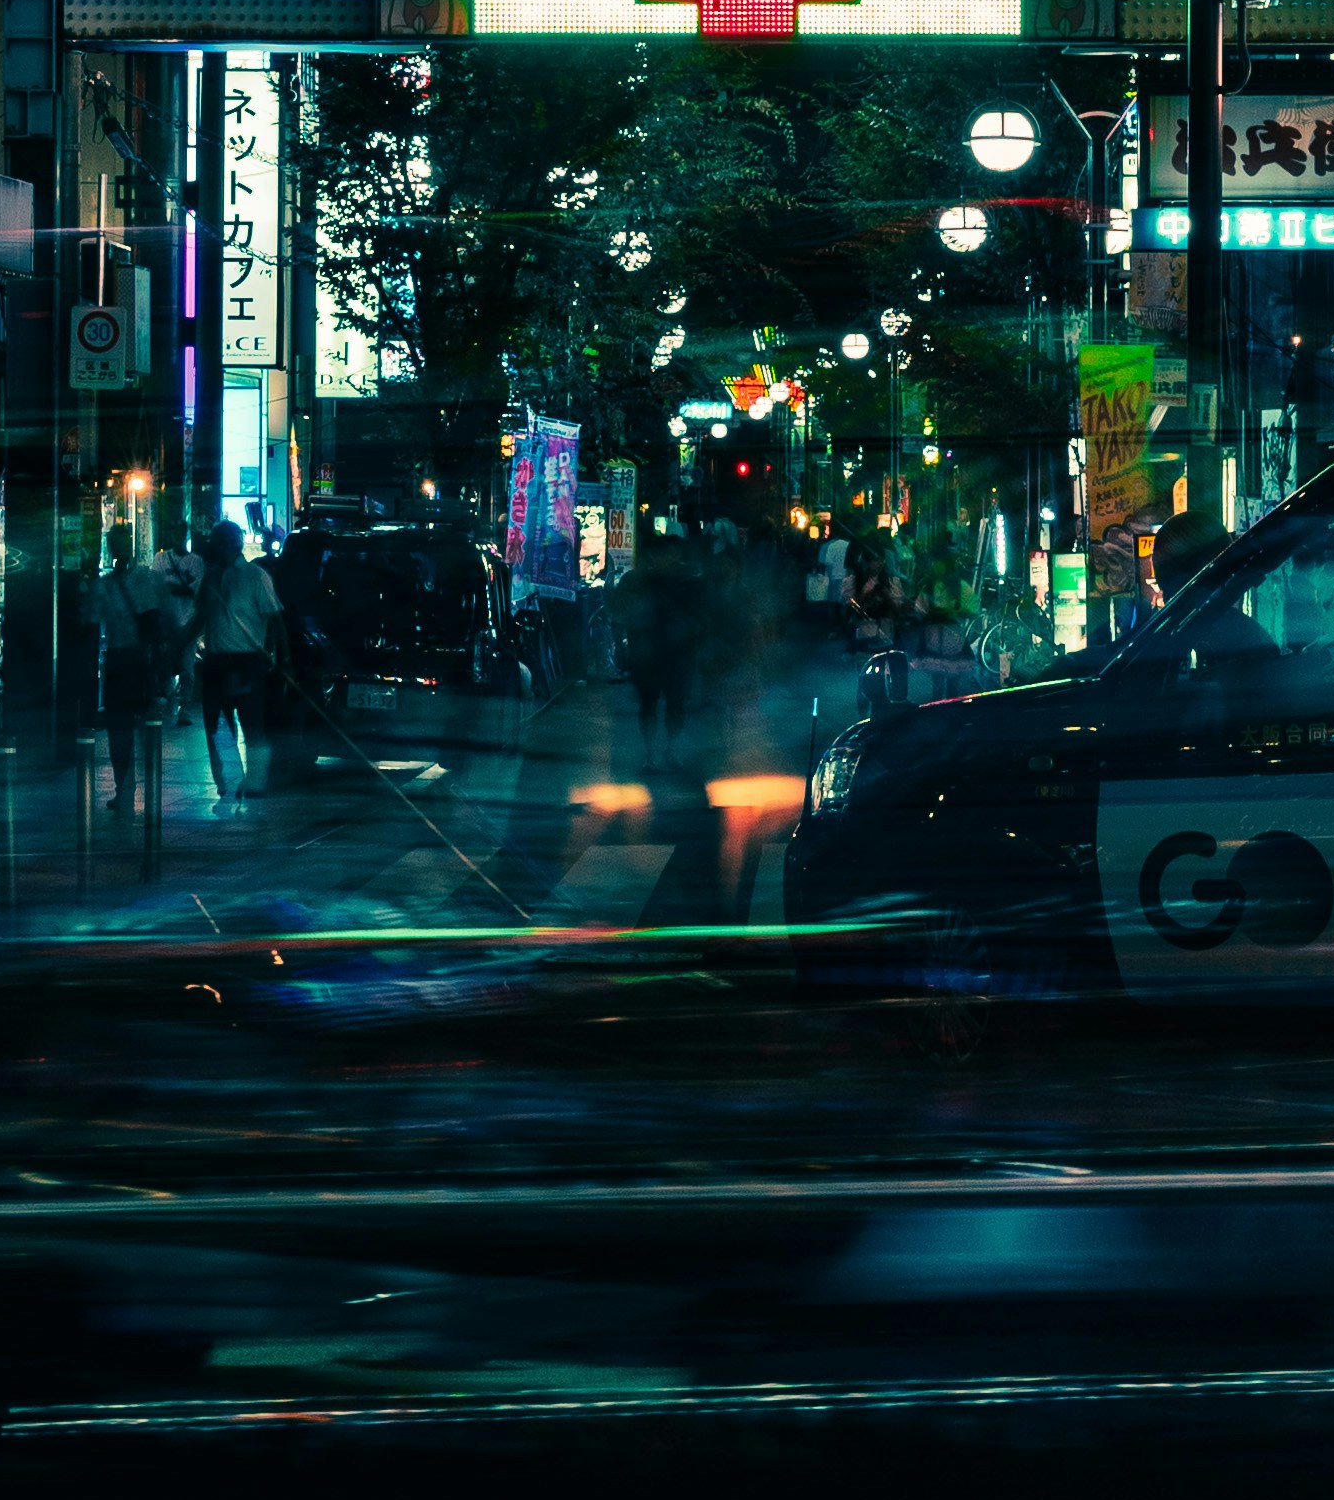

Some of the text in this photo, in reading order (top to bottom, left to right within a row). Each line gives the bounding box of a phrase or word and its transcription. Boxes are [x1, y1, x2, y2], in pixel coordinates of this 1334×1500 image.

[222, 88, 258, 323] ネットカフェ
[87, 322, 111, 342] 30
[1138, 829, 1334, 951] GO
